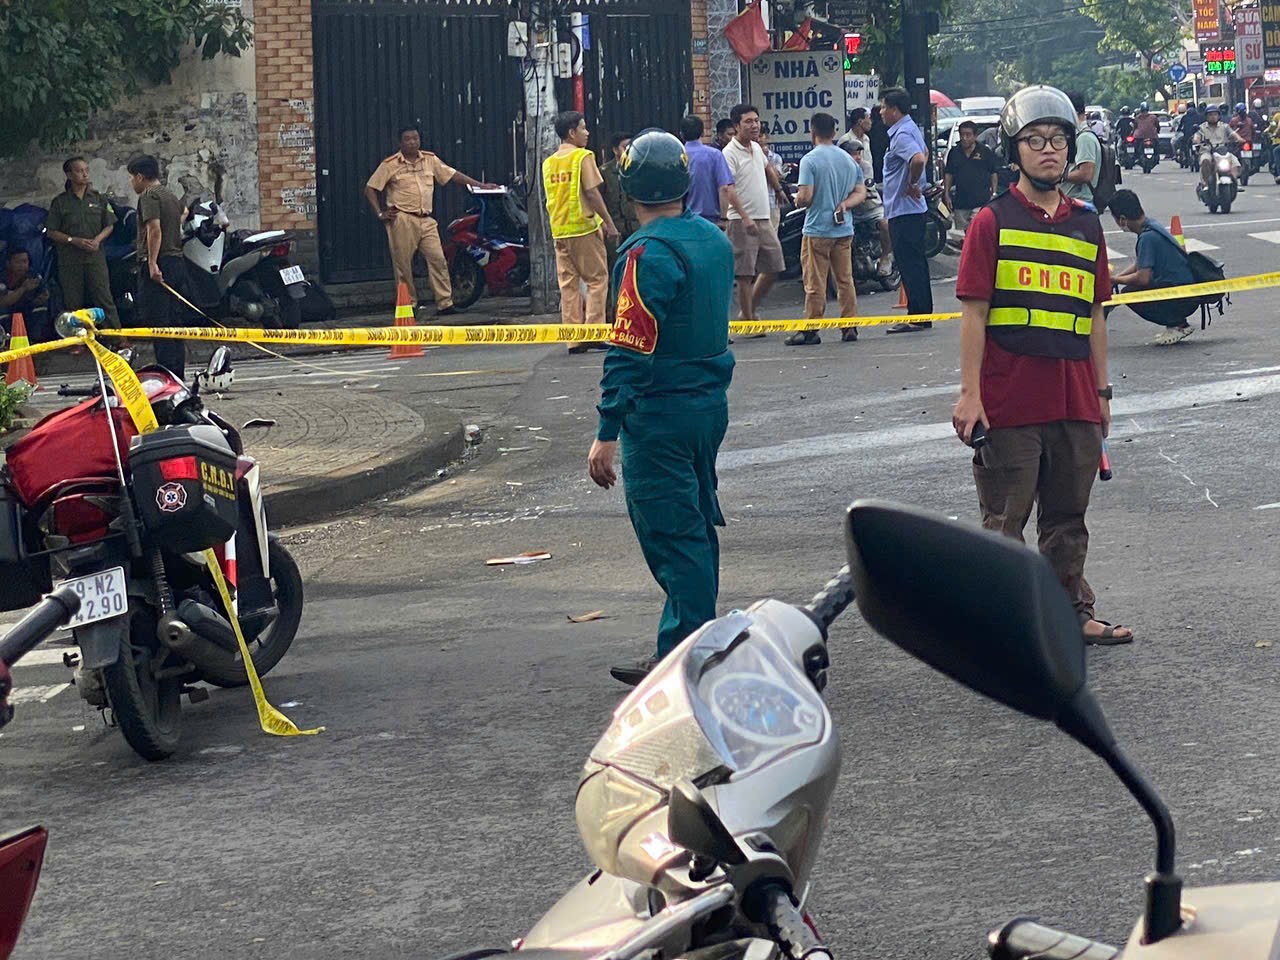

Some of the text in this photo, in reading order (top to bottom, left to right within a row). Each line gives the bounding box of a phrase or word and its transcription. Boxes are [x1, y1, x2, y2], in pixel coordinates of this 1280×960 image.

[774, 56, 819, 79] NHÀ
[762, 84, 833, 110] THUỐC
[1018, 266, 1085, 294] CNGT
[67, 573, 115, 600] 9-N2
